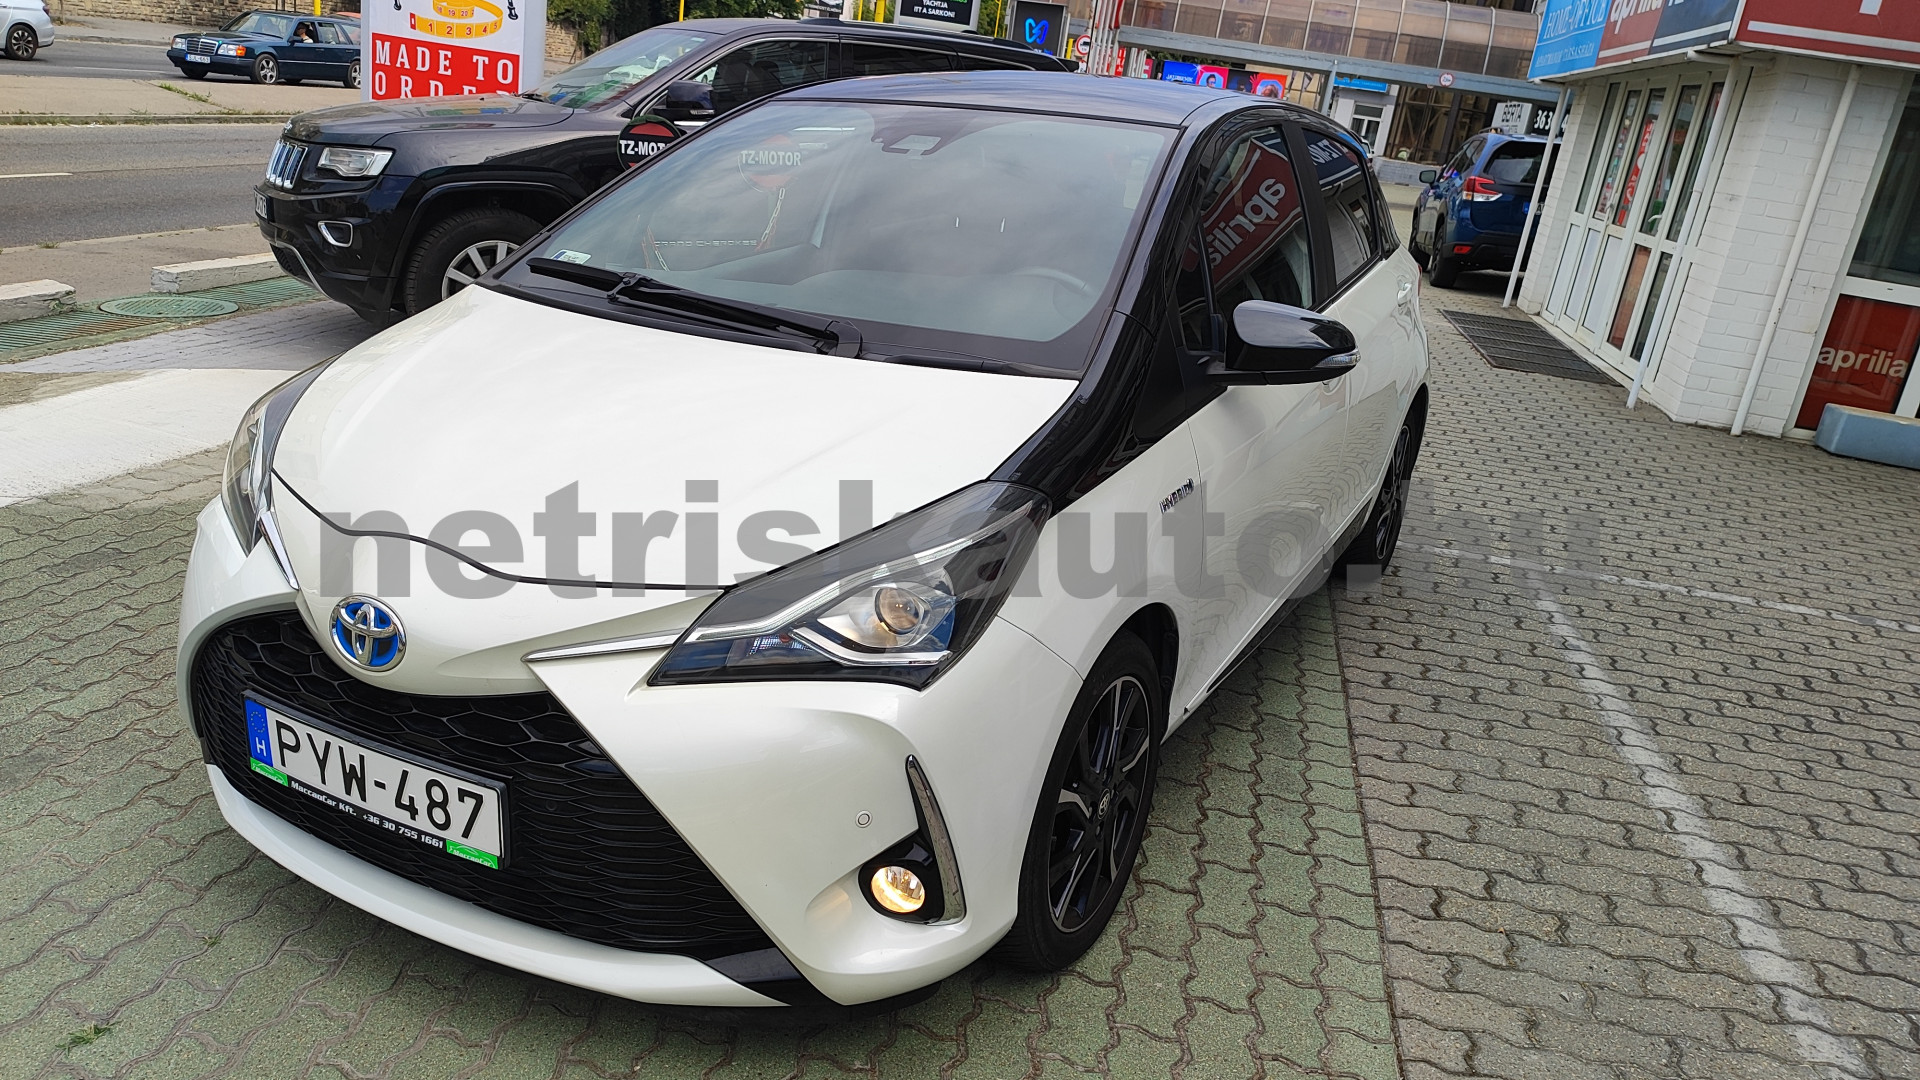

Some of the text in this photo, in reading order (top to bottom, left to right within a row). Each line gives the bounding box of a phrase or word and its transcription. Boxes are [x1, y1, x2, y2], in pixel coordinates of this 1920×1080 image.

[446, 25, 453, 35] 2
[465, 27, 472, 35] 3
[482, 25, 488, 33] 4
[375, 40, 514, 85] MADE TO
[374, 71, 510, 99] ORD
[619, 139, 671, 156] TZ-MOT
[740, 150, 802, 166] TZ-MOTOR
[1817, 346, 1909, 378] aprilia
[255, 737, 267, 757] H
[275, 719, 484, 839] PYW-487
[338, 802, 357, 816] Kft.
[362, 813, 380, 826] +36
[382, 820, 396, 832] 30
[398, 825, 418, 840] 755
[421, 834, 444, 849] 1661
